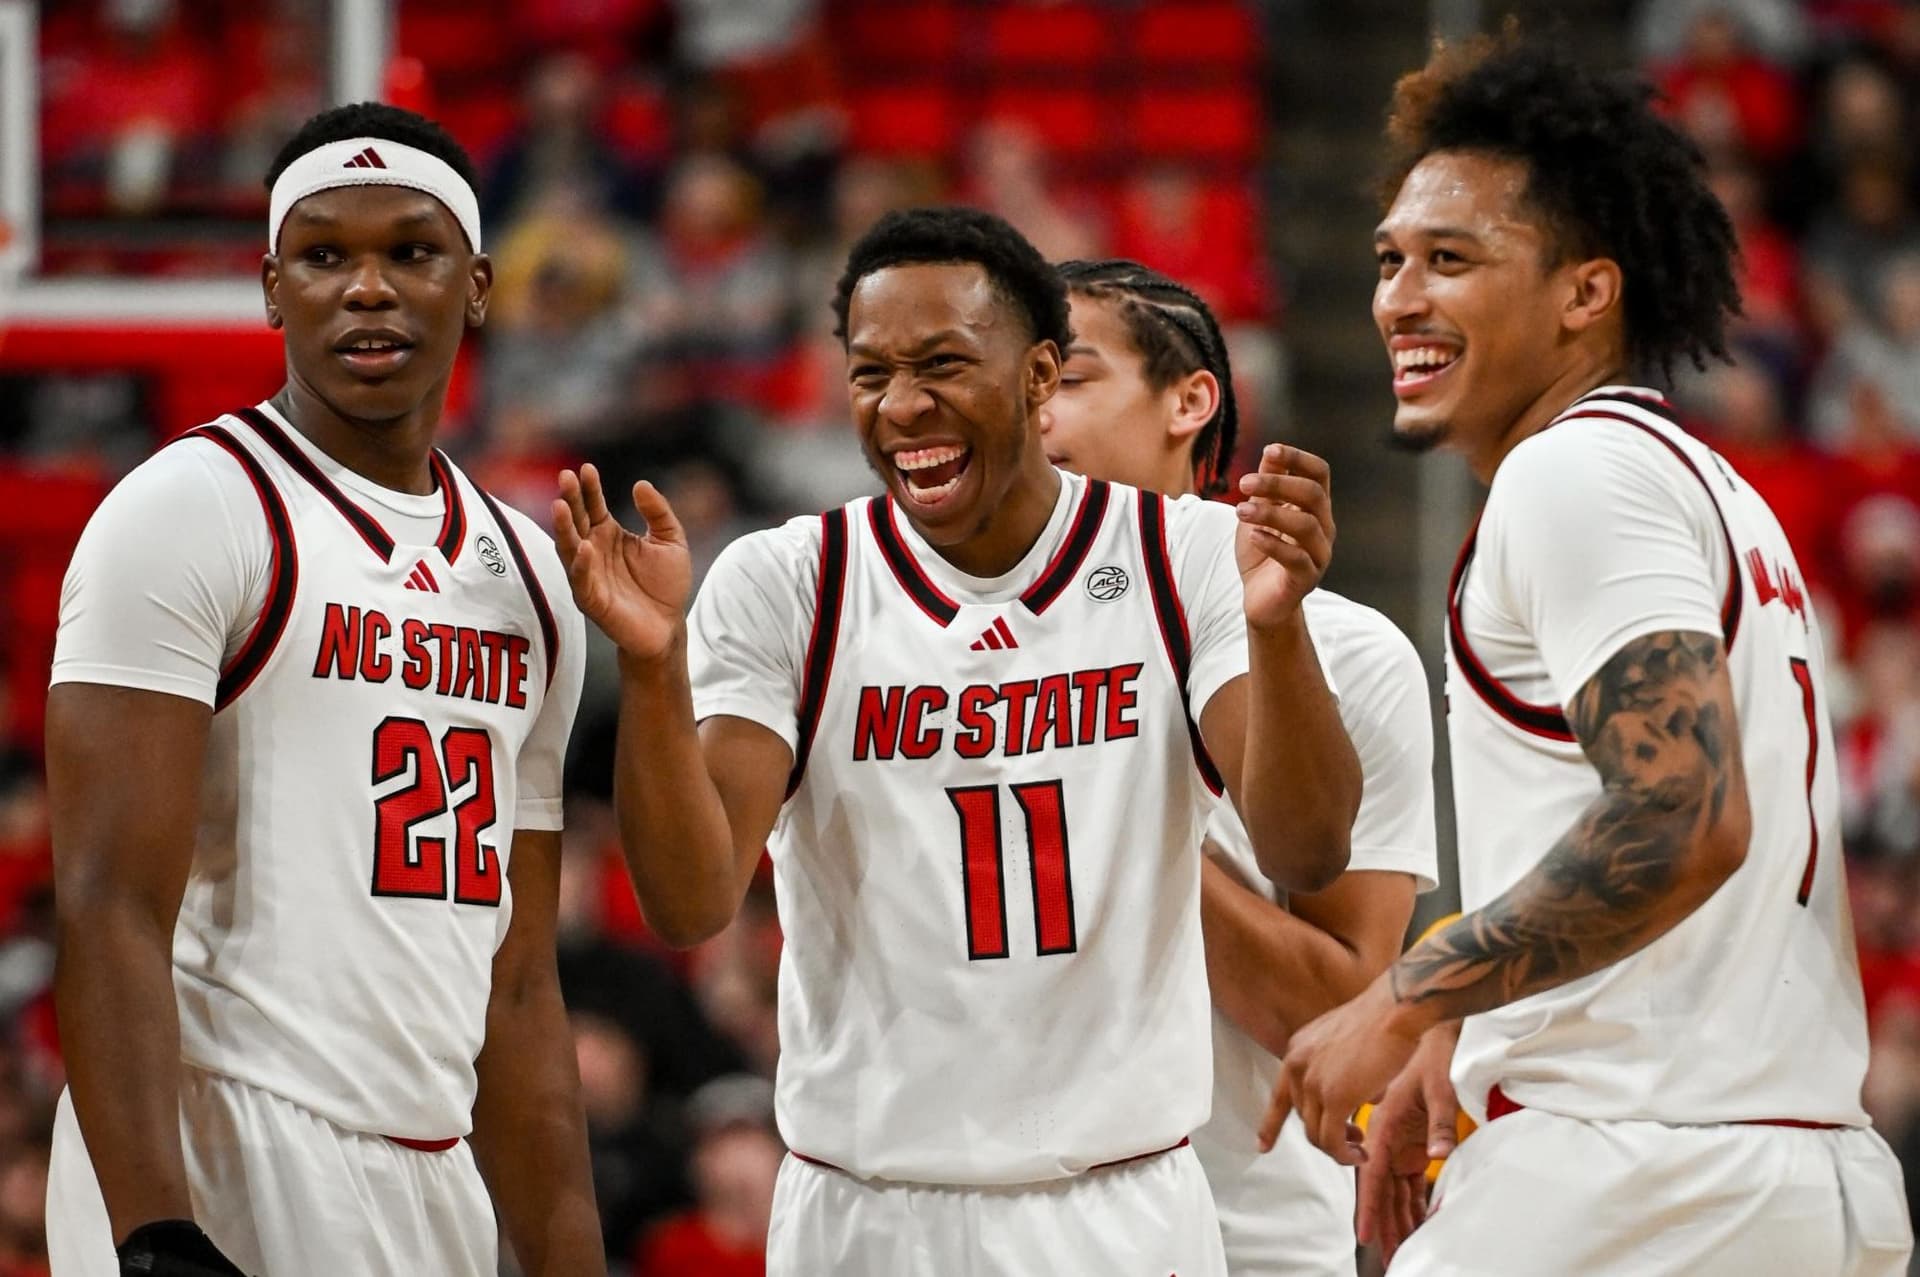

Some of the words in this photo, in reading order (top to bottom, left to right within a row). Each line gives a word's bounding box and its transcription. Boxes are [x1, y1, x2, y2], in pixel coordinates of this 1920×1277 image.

[1091, 574, 1126, 588] ACC
[312, 602, 392, 683] NC
[401, 618, 530, 710] STATE
[853, 685, 949, 761] NC
[954, 662, 1144, 760] STATE
[371, 716, 501, 907] 22
[1789, 656, 1818, 908] 1
[944, 779, 1077, 961] 11
